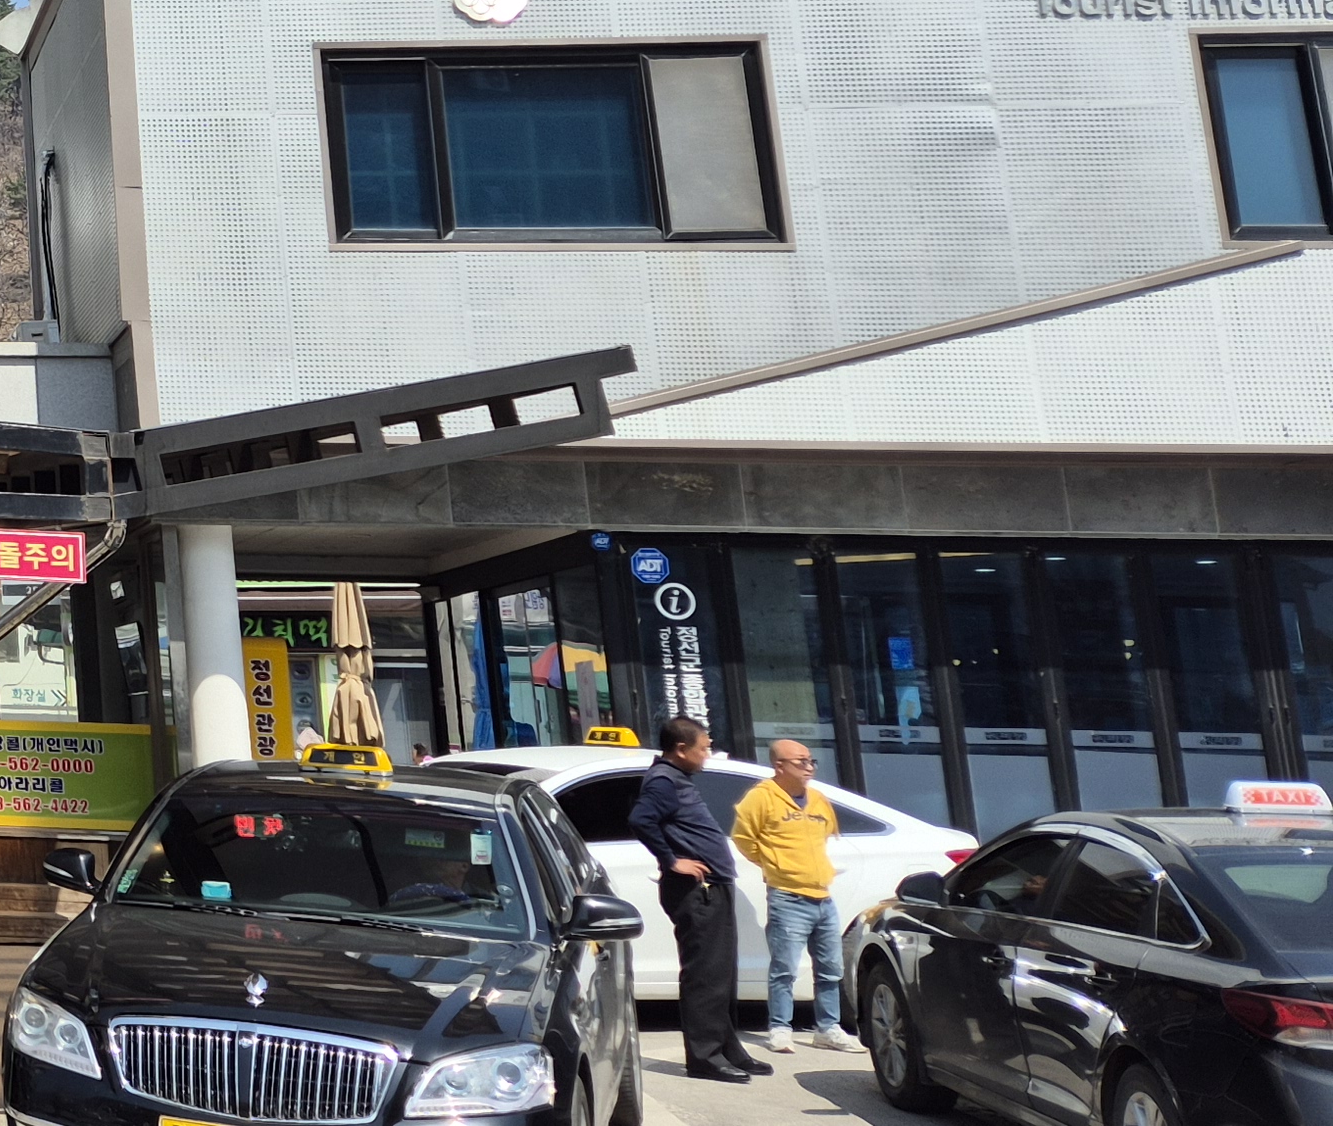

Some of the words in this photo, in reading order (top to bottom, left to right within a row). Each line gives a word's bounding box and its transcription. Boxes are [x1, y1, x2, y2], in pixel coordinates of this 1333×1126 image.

[637, 559, 664, 572] ADT
[659, 627, 675, 669] Tourist
[11, 688, 46, 703] 화장실
[663, 674, 679, 719] Inform
[1254, 788, 1308, 805] TAXI
